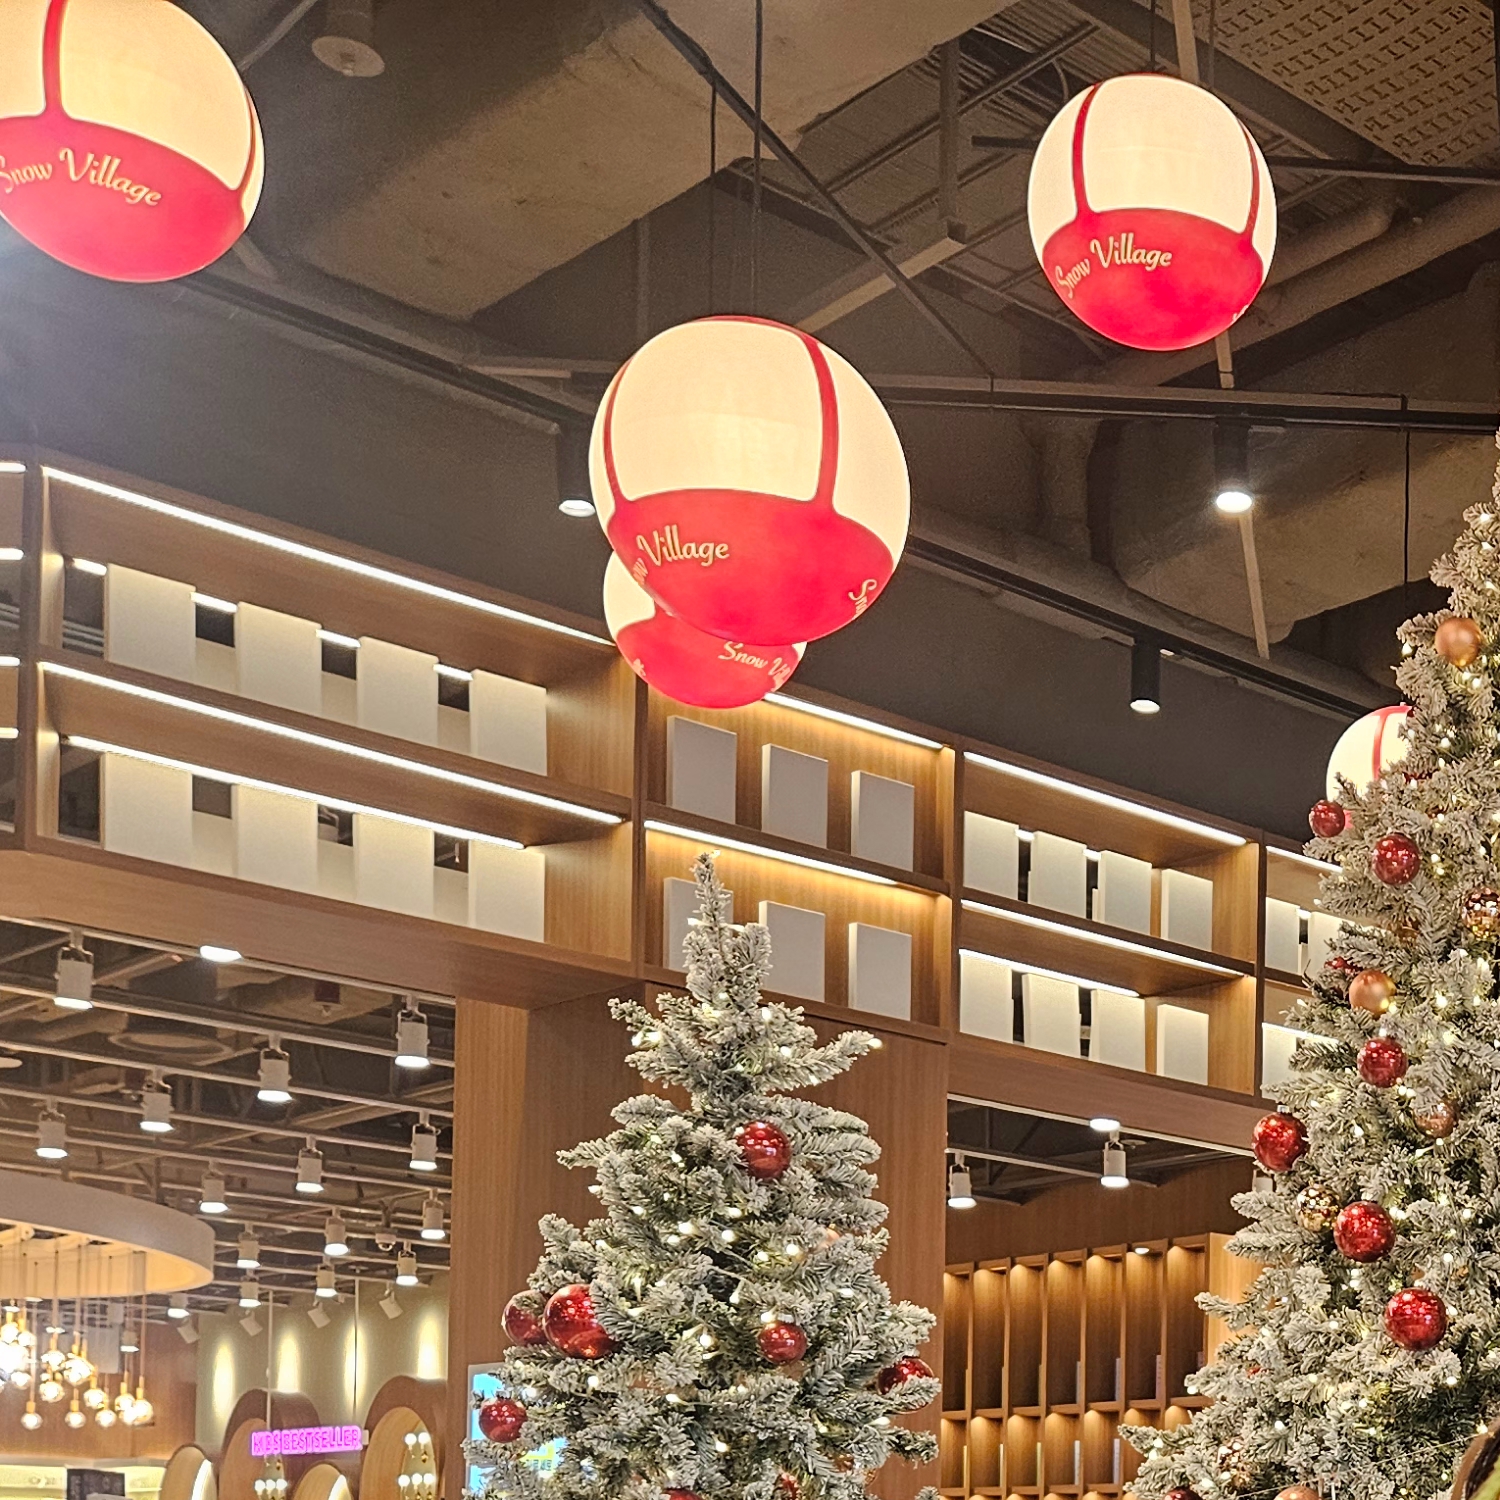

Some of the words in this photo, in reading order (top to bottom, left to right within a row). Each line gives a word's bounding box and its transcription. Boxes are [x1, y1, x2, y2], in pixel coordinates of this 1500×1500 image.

[0, 155, 52, 194] Snow
[59, 148, 162, 206] Village
[1055, 258, 1091, 299] Snow
[1090, 233, 1172, 271] Village
[636, 525, 730, 566] Village
[718, 640, 767, 669] Snow
[281, 1425, 363, 1455] BESTSELLER
